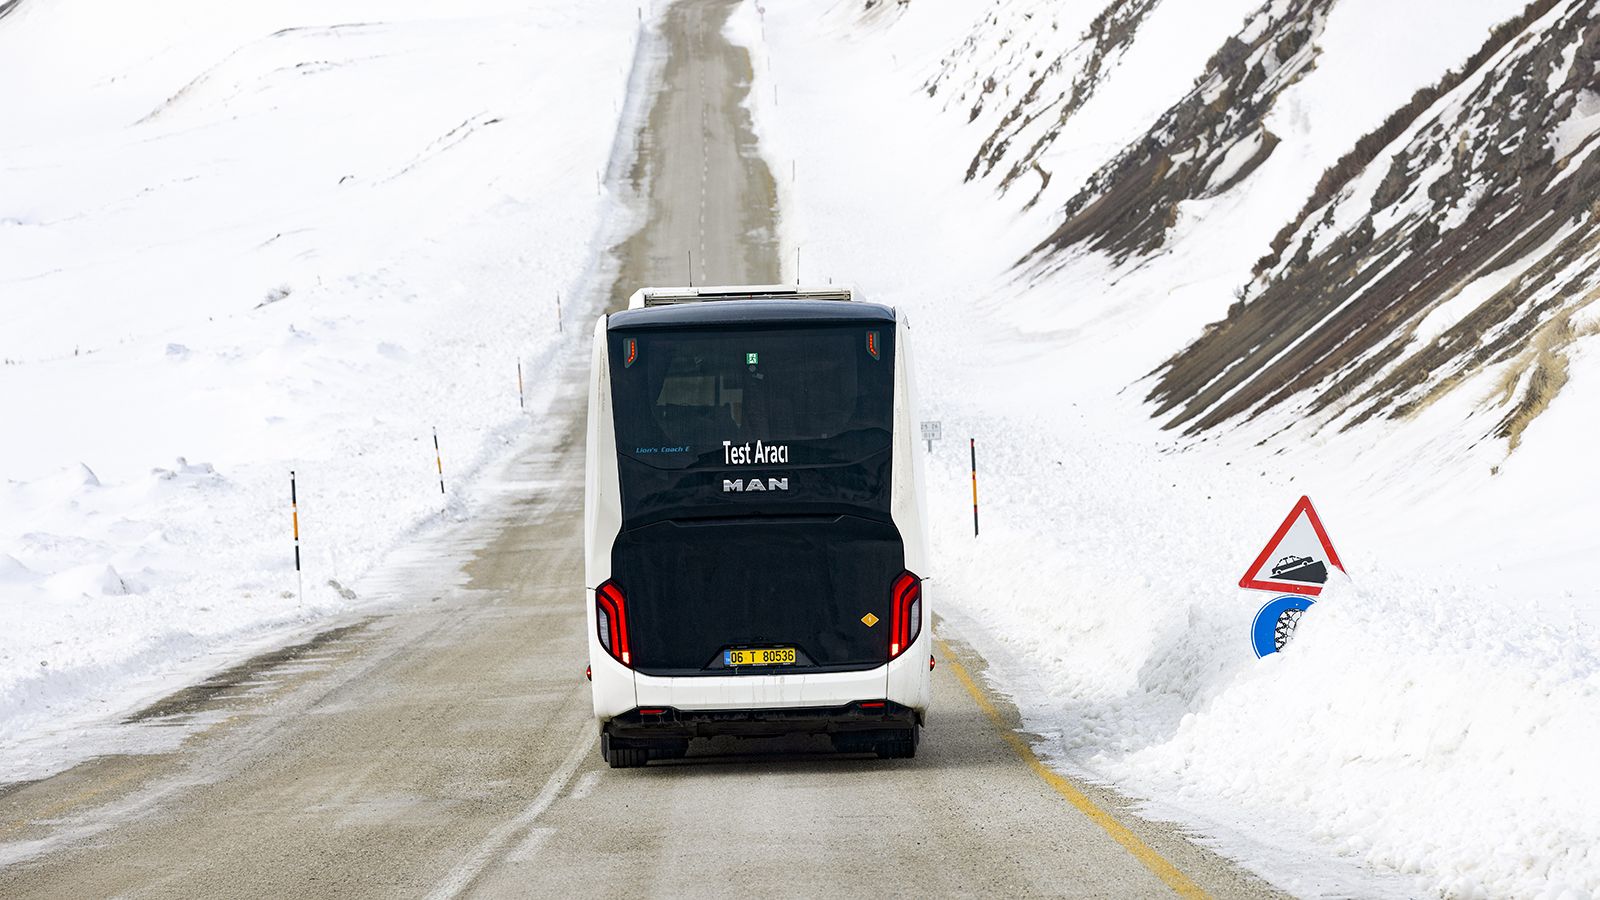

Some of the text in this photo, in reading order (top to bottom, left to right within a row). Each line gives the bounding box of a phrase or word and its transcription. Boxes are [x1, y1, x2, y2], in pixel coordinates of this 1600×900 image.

[722, 439, 789, 465] Test Aracı
[722, 477, 789, 492] MAN
[731, 652, 744, 663] 06
[750, 651, 756, 662] T
[763, 650, 794, 662] 80536
